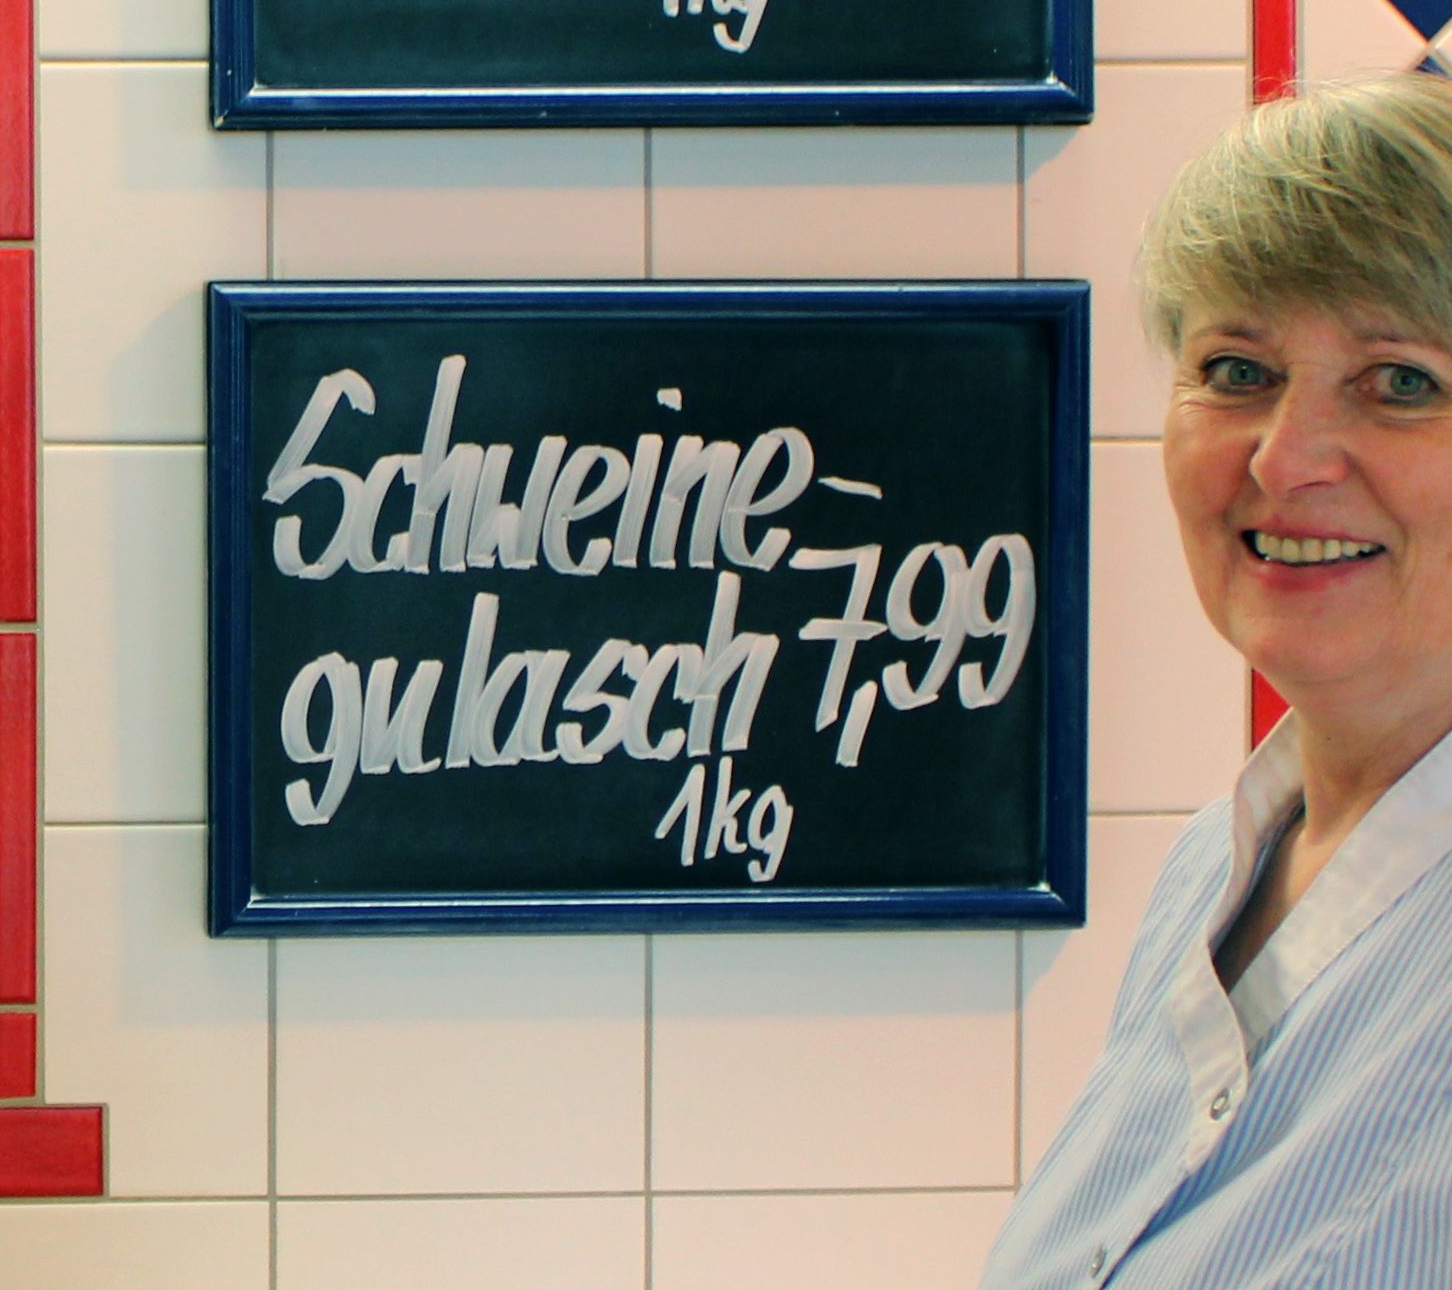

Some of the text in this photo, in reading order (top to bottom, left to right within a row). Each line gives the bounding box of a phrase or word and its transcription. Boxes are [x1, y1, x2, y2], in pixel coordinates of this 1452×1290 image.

[262, 353, 884, 580] Schweine-
[279, 533, 1037, 826] gulasch 7,99
